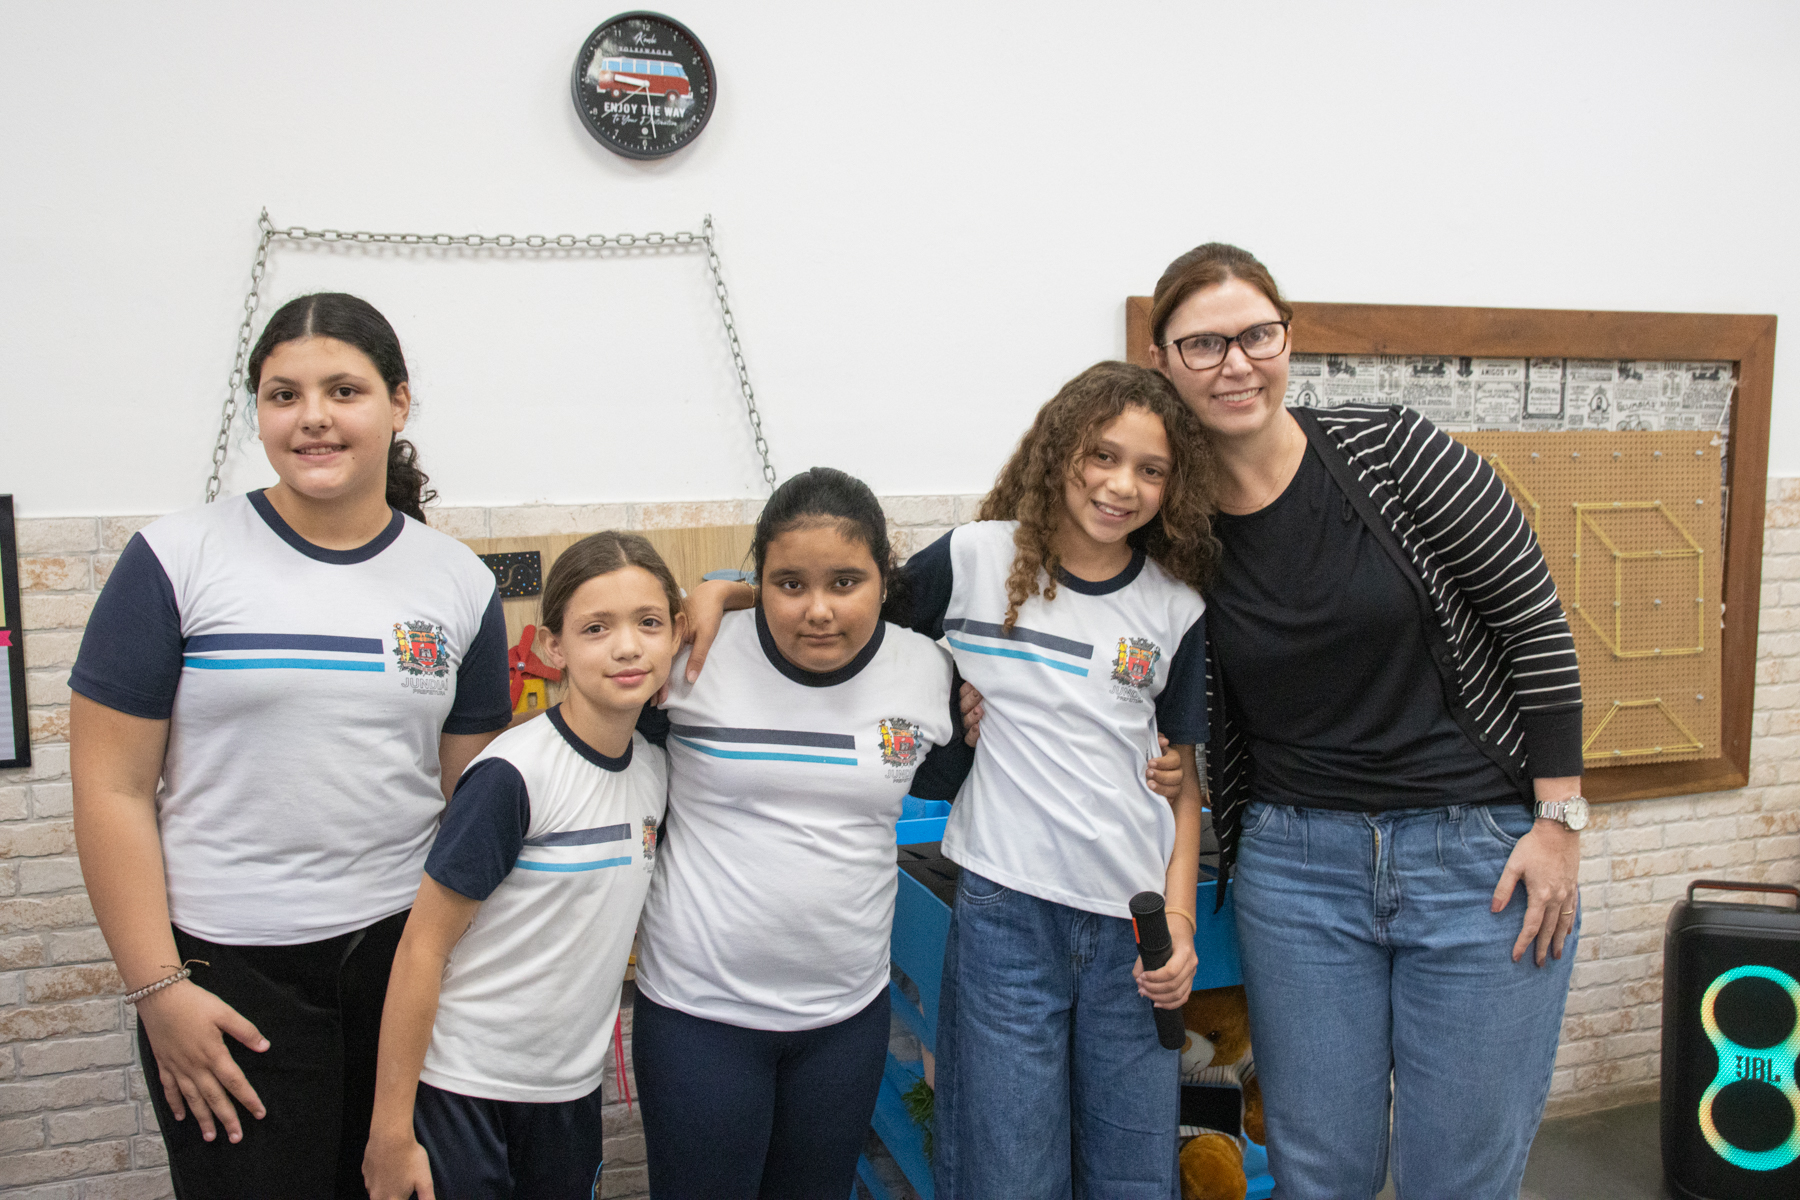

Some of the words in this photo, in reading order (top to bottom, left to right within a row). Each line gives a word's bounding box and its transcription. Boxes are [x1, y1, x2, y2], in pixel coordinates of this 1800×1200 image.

[618, 46, 674, 57] VOLKSWAGEN
[604, 101, 638, 115] ENJOY
[641, 104, 661, 116] THE
[664, 106, 686, 118] WAY
[1736, 1055, 1781, 1082] JBL
